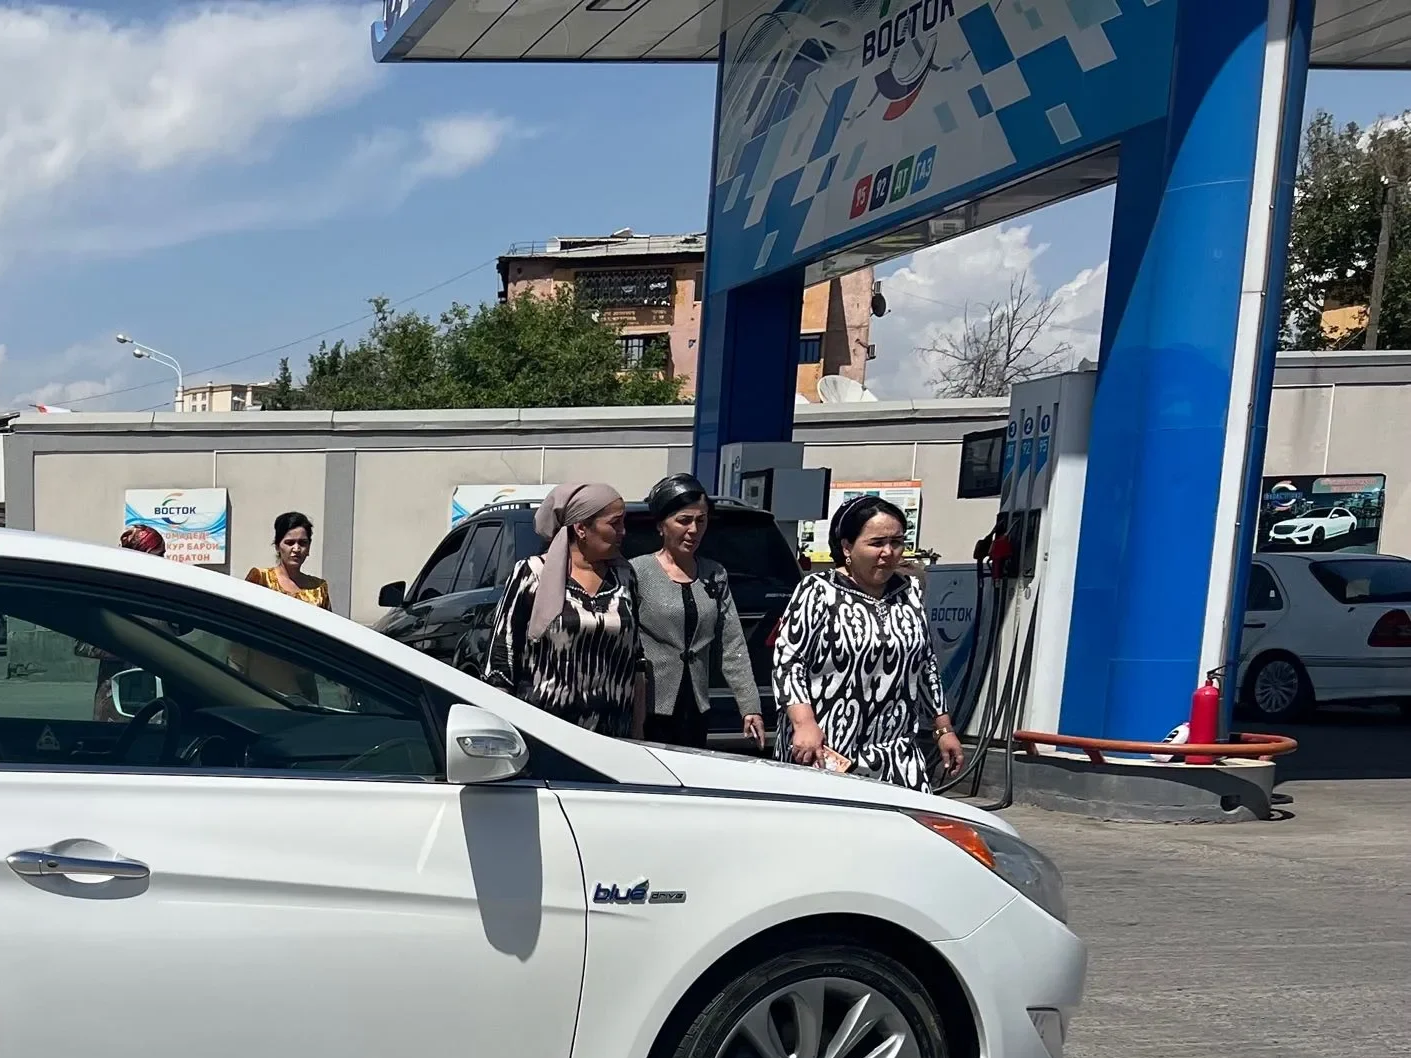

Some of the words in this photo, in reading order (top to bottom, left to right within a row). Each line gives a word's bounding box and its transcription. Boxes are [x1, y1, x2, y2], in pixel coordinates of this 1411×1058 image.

[862, 0, 955, 68] ВОСТОК
[875, 177, 888, 199] 92
[914, 157, 933, 182] ГАЗ
[154, 506, 196, 515] ВОСТОК
[931, 607, 973, 622] ВОСТОК
[593, 880, 649, 904] blue
[650, 891, 685, 901] drive
